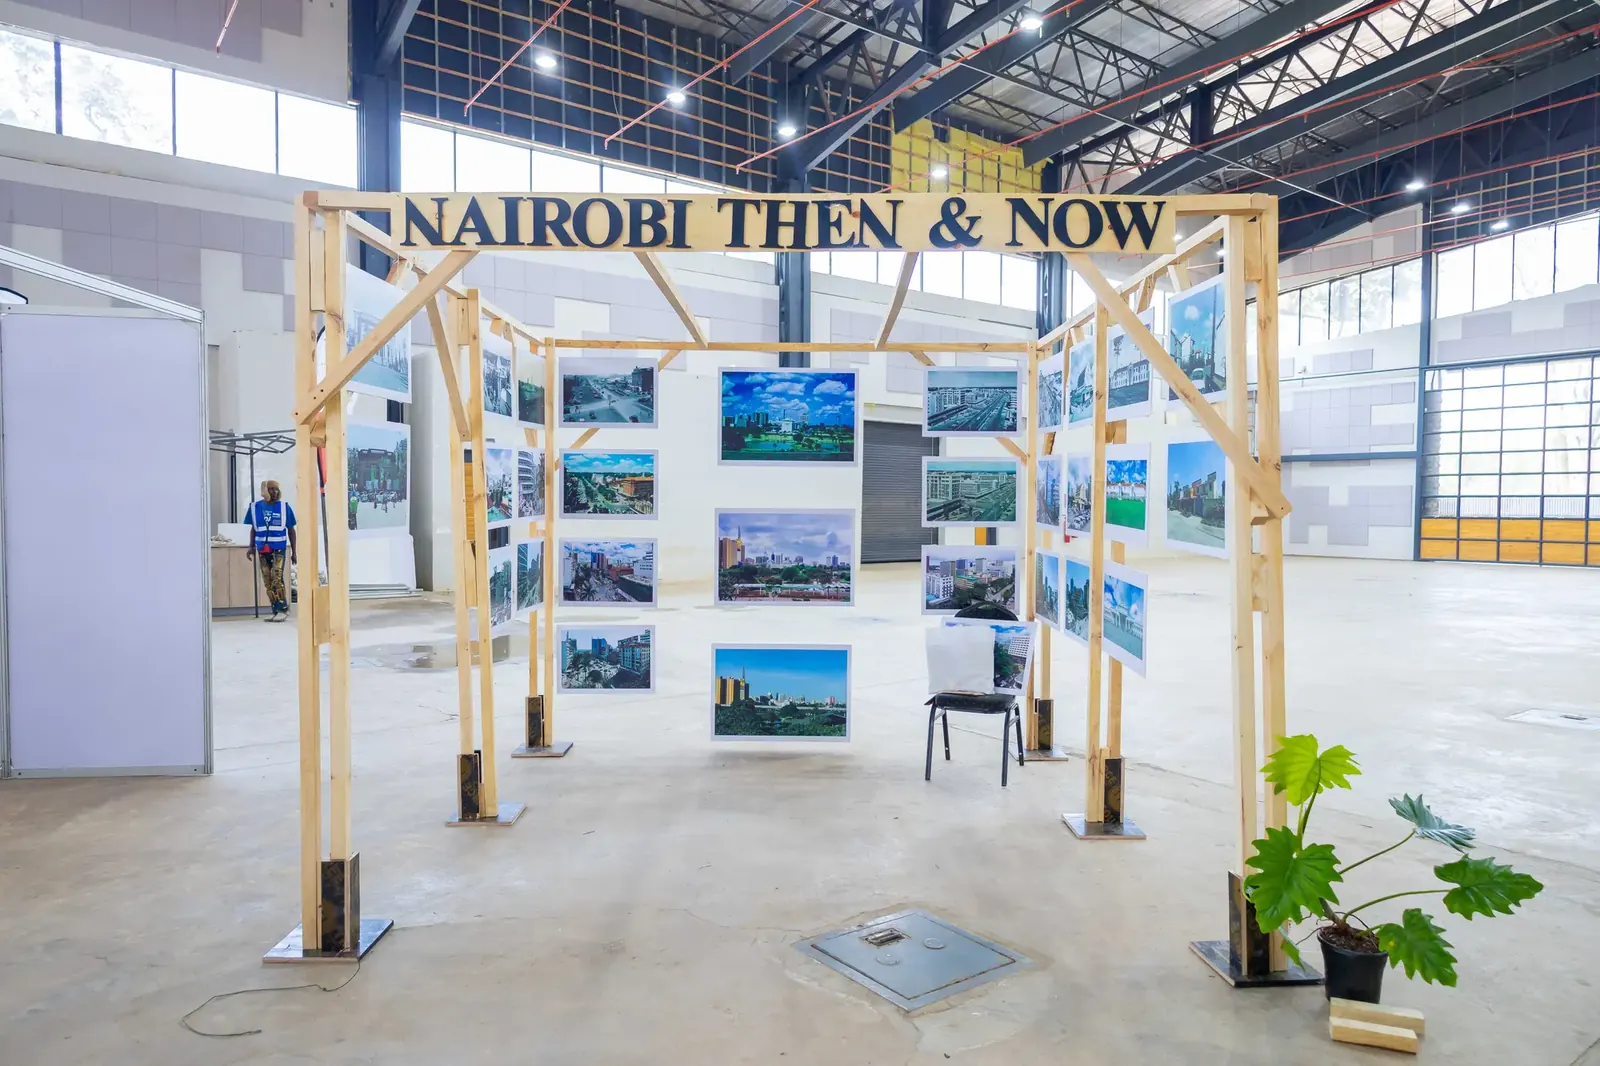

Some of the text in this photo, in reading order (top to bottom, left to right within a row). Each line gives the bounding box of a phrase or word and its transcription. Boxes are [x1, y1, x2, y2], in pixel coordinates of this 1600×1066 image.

[400, 196, 1167, 250] NAIROBI THEN & NOW
